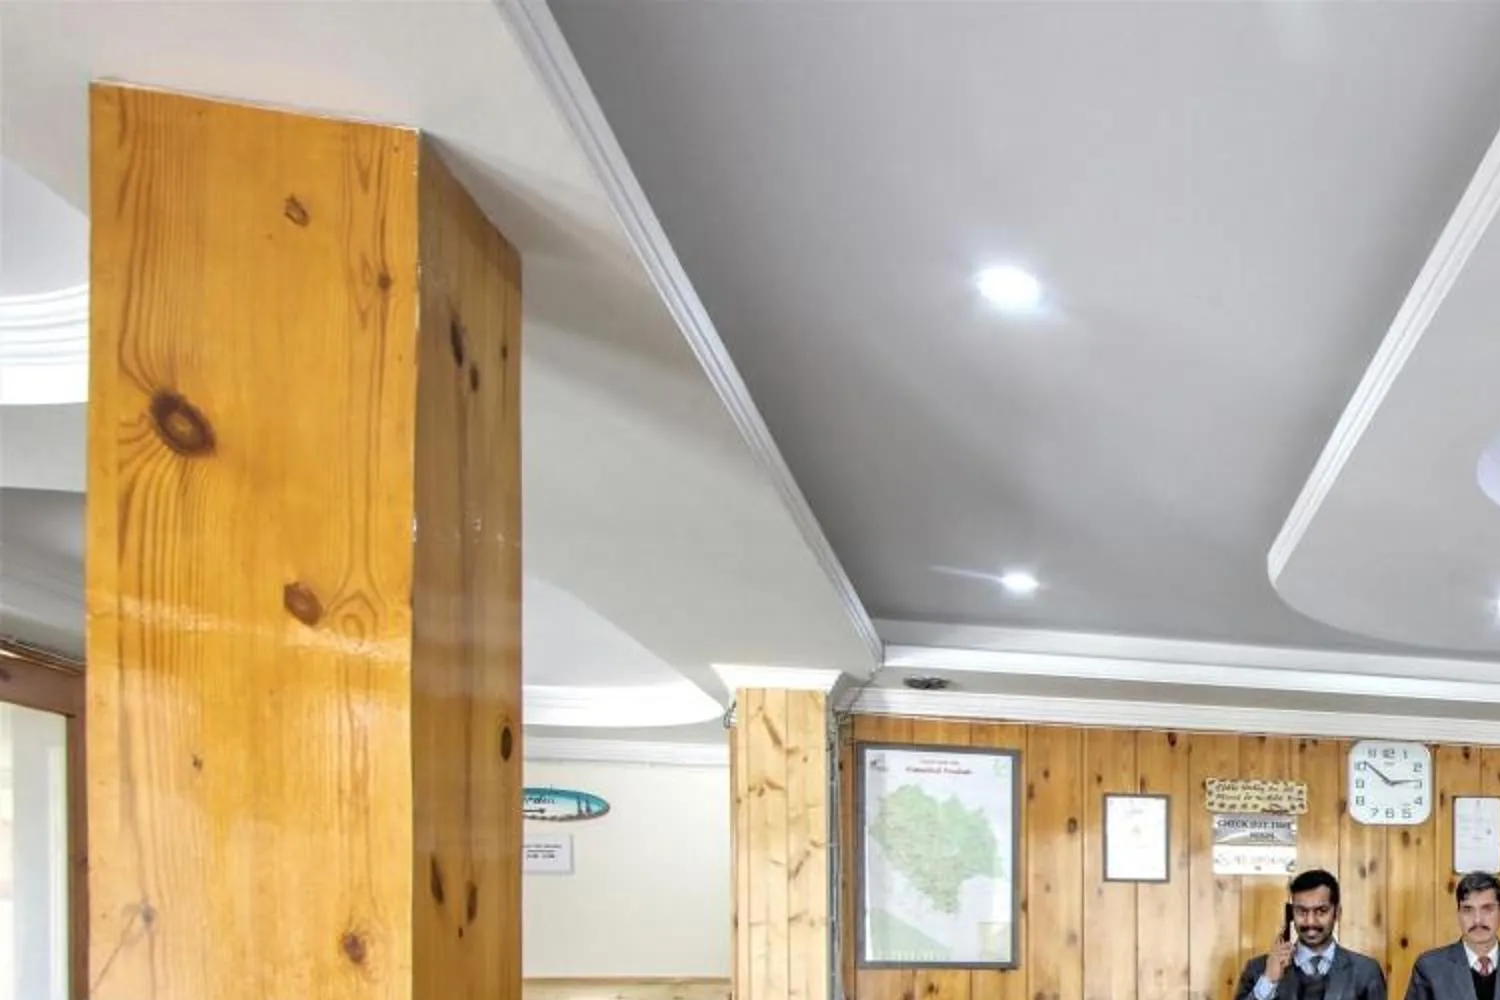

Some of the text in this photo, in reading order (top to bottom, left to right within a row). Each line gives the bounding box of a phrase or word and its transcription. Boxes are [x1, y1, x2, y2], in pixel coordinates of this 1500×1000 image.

[1413, 761, 1423, 773] 2
[1413, 796, 1423, 806] 4
[1369, 807, 1413, 819] 7 6 5
